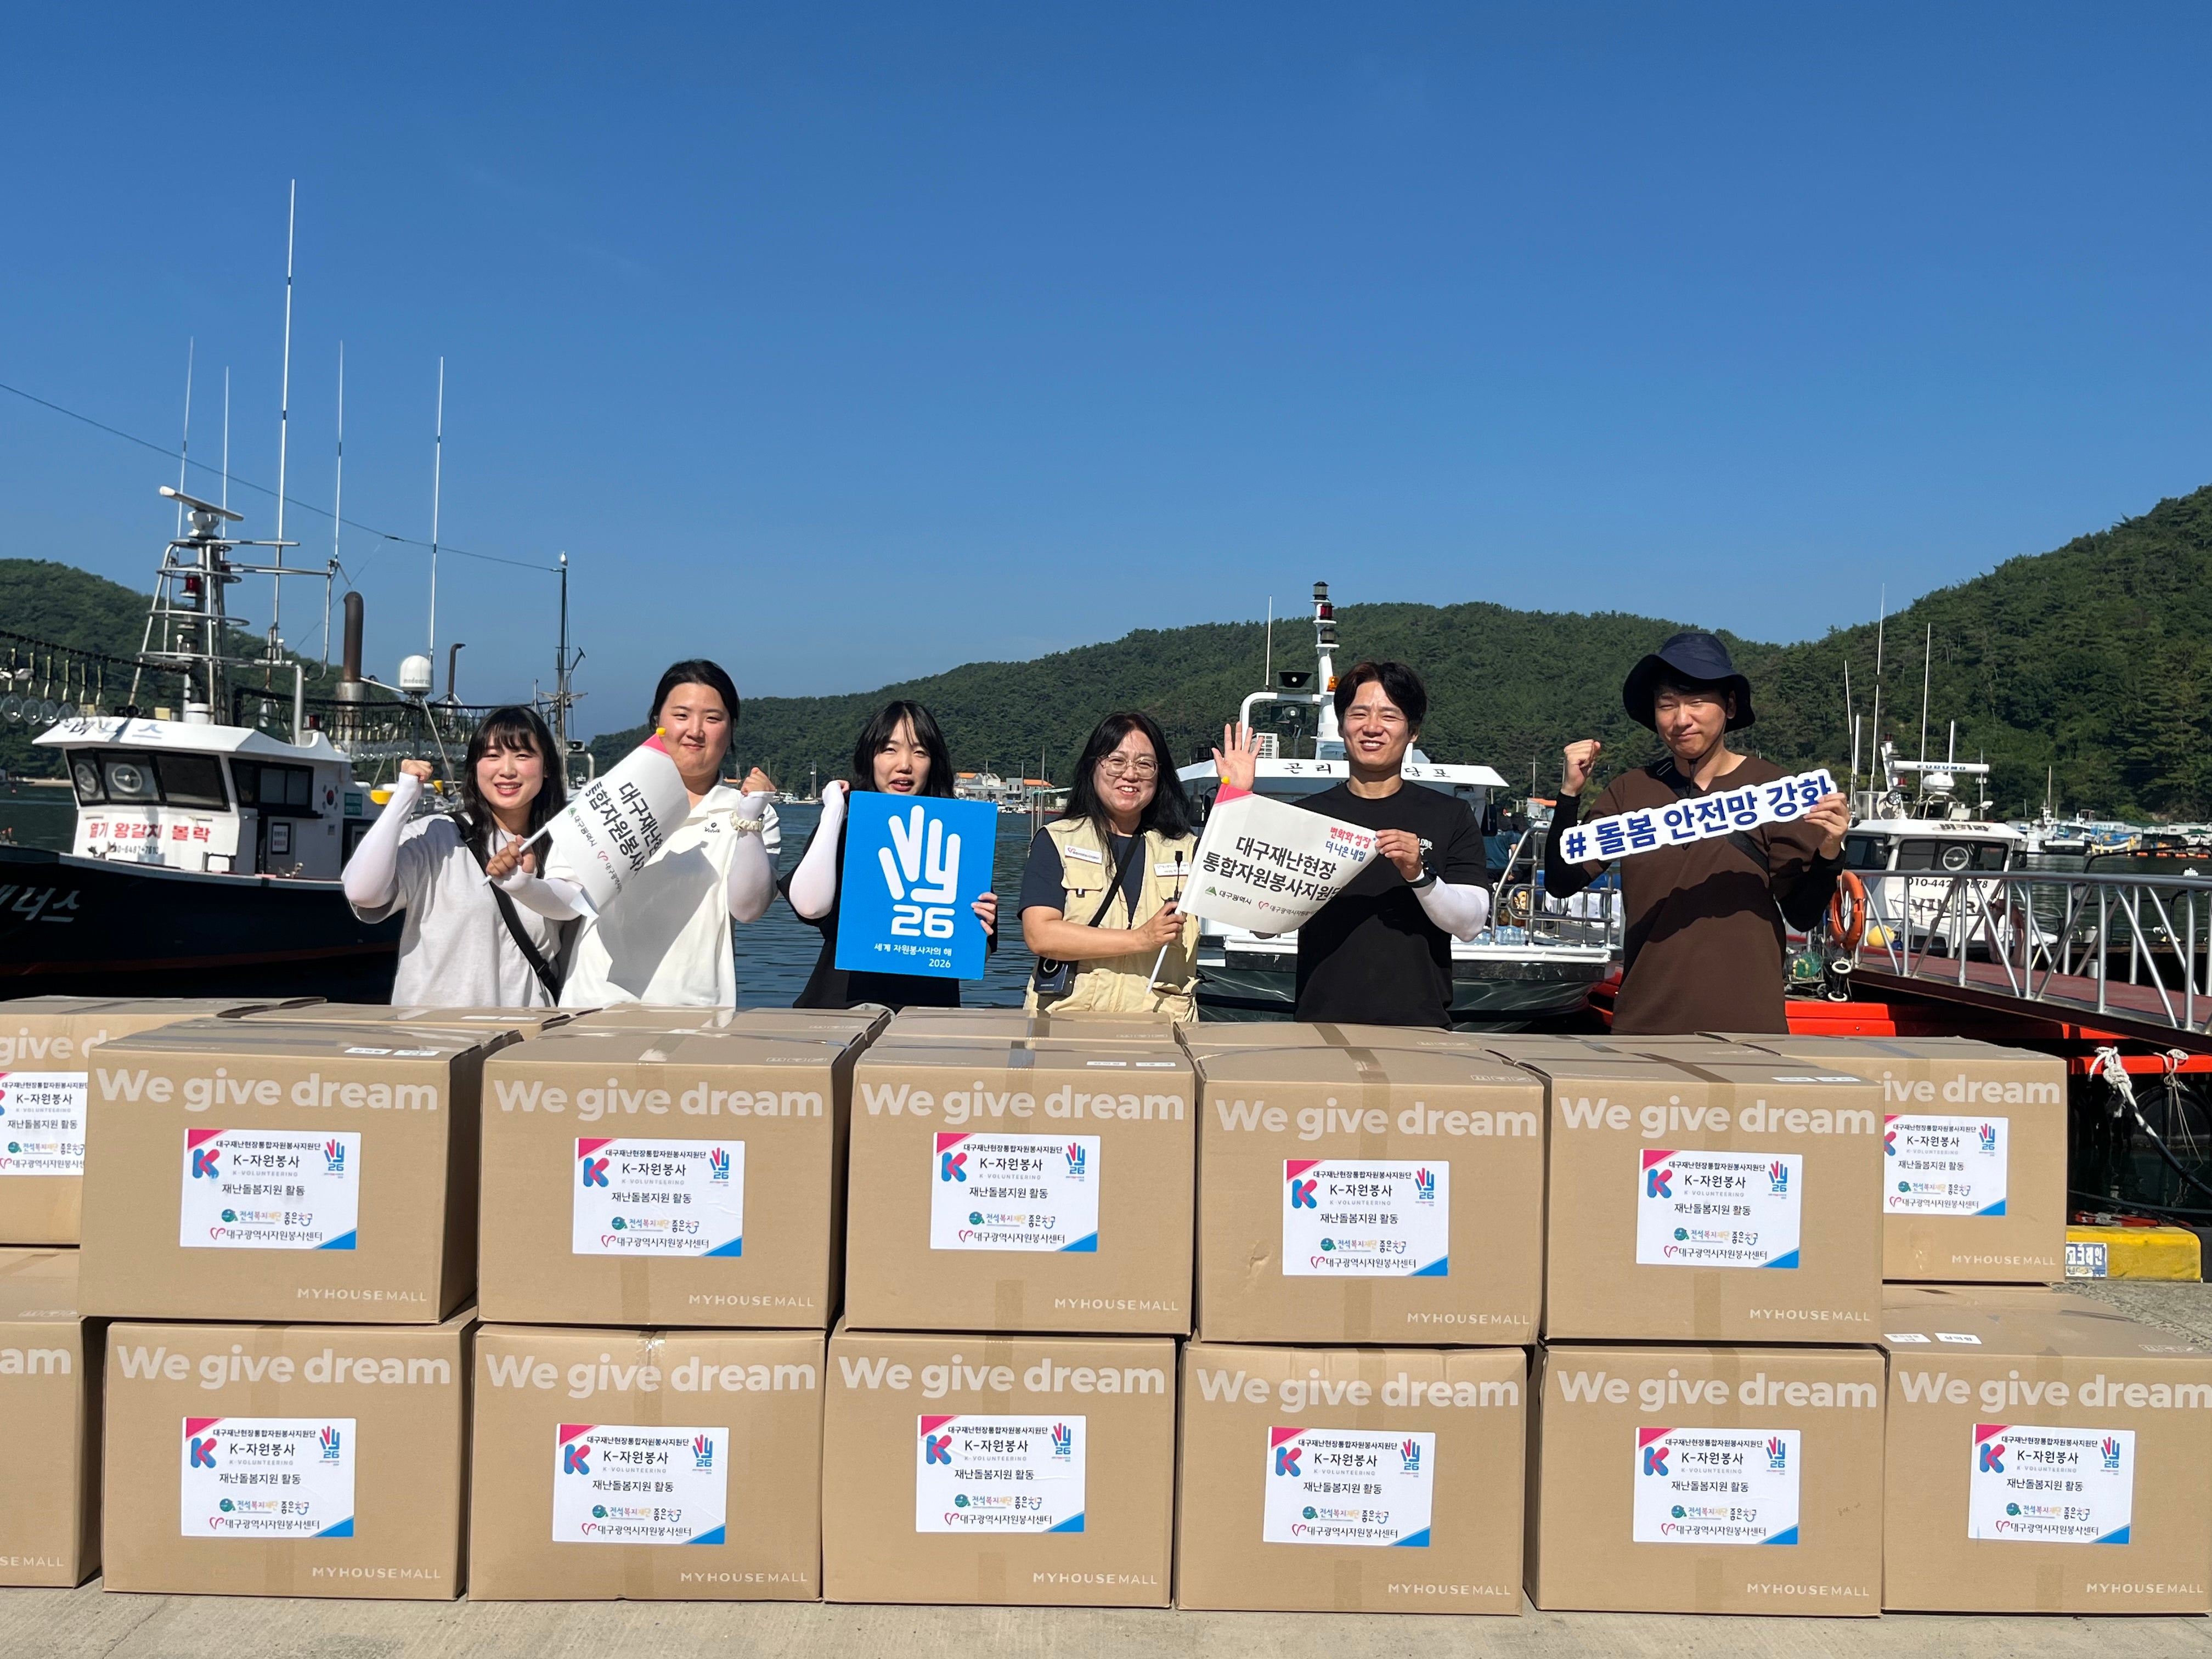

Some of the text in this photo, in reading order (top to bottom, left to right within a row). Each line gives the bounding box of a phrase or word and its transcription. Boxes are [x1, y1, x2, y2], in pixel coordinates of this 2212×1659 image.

[1566, 775, 1831, 859] # 돌봄 안전망 강화
[1354, 834, 1372, 849] 성장
[1325, 840, 1334, 850] 더
[1352, 848, 1366, 862] 내일
[1235, 836, 1337, 880] 대구재난현장
[1218, 890, 1252, 905] 대구광역시
[891, 904, 955, 939] 26
[874, 943, 952, 957] 세계 자원봉사자의 해
[928, 958, 951, 969] 2026
[97, 1068, 437, 1112] We give dream
[1883, 1071, 2060, 1105] ive dream
[16, 1093, 73, 1105] K-자원봉사
[495, 1077, 822, 1121] We give dream
[861, 1081, 1184, 1125] We give dream
[1216, 1098, 1537, 1141] We give dream
[1560, 1096, 1876, 1139] We give dream
[61, 1119, 78, 1130] 활동
[216, 1140, 321, 1150] 대구재난현장통합자원봉사지원단
[1906, 1135, 1960, 1148] K-자원봉사
[605, 1149, 707, 1159] 대구재난현장통합자원봉사지원단
[963, 1143, 1063, 1154] 대구재난현장통합자원봉사지원단
[233, 1154, 301, 1169] K-자원봉사
[980, 1157, 1043, 1172] K-자원봉사
[1668, 1161, 1765, 1171] 대구재난현장통합자원봉사지원단
[1948, 1161, 1965, 1171] 활동
[622, 1163, 687, 1177] K-자원봉사
[1313, 1171, 1412, 1179] 대구재난현장통합자원봉사지원단
[1684, 1174, 1746, 1189] K-자원봉사
[221, 1183, 306, 1197] 재난돌봄지원 활동
[969, 1187, 1049, 1199] 재난돌봄지원 활동
[1330, 1184, 1392, 1197] K-자원봉사
[611, 1192, 692, 1204] 재난돌봄지원 활동
[1674, 1203, 1752, 1216] 재난돌봄지원 활동
[1320, 1213, 1399, 1224] 재난돌봄지원 활동
[226, 1229, 323, 1242] 대구광역시자원봉사센터
[973, 1232, 1065, 1244] 대구광역시자원봉사센터
[617, 1237, 709, 1249] 대구광역시자원봉사센터
[1678, 1248, 1768, 1260] 대구광역시자원봉사센터
[1325, 1258, 1416, 1268] 대구광역시자원봉사센터
[117, 1344, 450, 1390] We give dream
[487, 1353, 816, 1398] We give dream
[839, 1355, 1165, 1398] We give dream
[1197, 1369, 1519, 1413] We give dream
[1558, 1369, 1877, 1412] We give dream
[1900, 1370, 2212, 1413] We give dream
[212, 1429, 316, 1438] 대구재난현장통합자원봉사지원단
[947, 1426, 1048, 1435] 대구재난현장통합자원봉사지원단
[586, 1436, 689, 1446] 대구재난현장통합자원봉사지원단
[964, 1439, 1029, 1453] K-자원봉사
[1297, 1439, 1398, 1450] 대구재난현장통합자원봉사지원단
[1665, 1438, 1763, 1447] 대구재난현장통합자원봉사지원단
[2001, 1435, 2098, 1447] 대구재난현장통합자원봉사지원단
[230, 1443, 296, 1457] K-자원봉사
[603, 1450, 669, 1465] K-자원봉사
[1314, 1453, 1378, 1468] K-자원봉사
[1681, 1452, 1744, 1465] K-자원봉사
[2017, 1449, 2079, 1465] K-자원봉사
[219, 1473, 302, 1485] 재난돌봄지원 활동
[954, 1469, 1035, 1481] 재난돌봄지원 활동
[592, 1480, 675, 1492] 재난돌봄지원 활동
[1302, 1481, 1383, 1495] 재난돌봄지원 활동
[1671, 1481, 1750, 1493] 재난돌봄지원 활동
[2006, 1478, 2084, 1492] 재난돌봄지원 활동
[225, 1519, 319, 1530] 대구광역시자원봉사센터
[960, 1514, 1052, 1525] 대구광역시자원봉사센터
[597, 1525, 691, 1537] 대구광역시자원봉사센터
[1307, 1526, 1398, 1539] 대구광역시자원봉사센터
[1676, 1525, 1766, 1537] 대구광역시자원봉사센터
[2010, 1522, 2099, 1536] 대구광역시자원봉사센터
